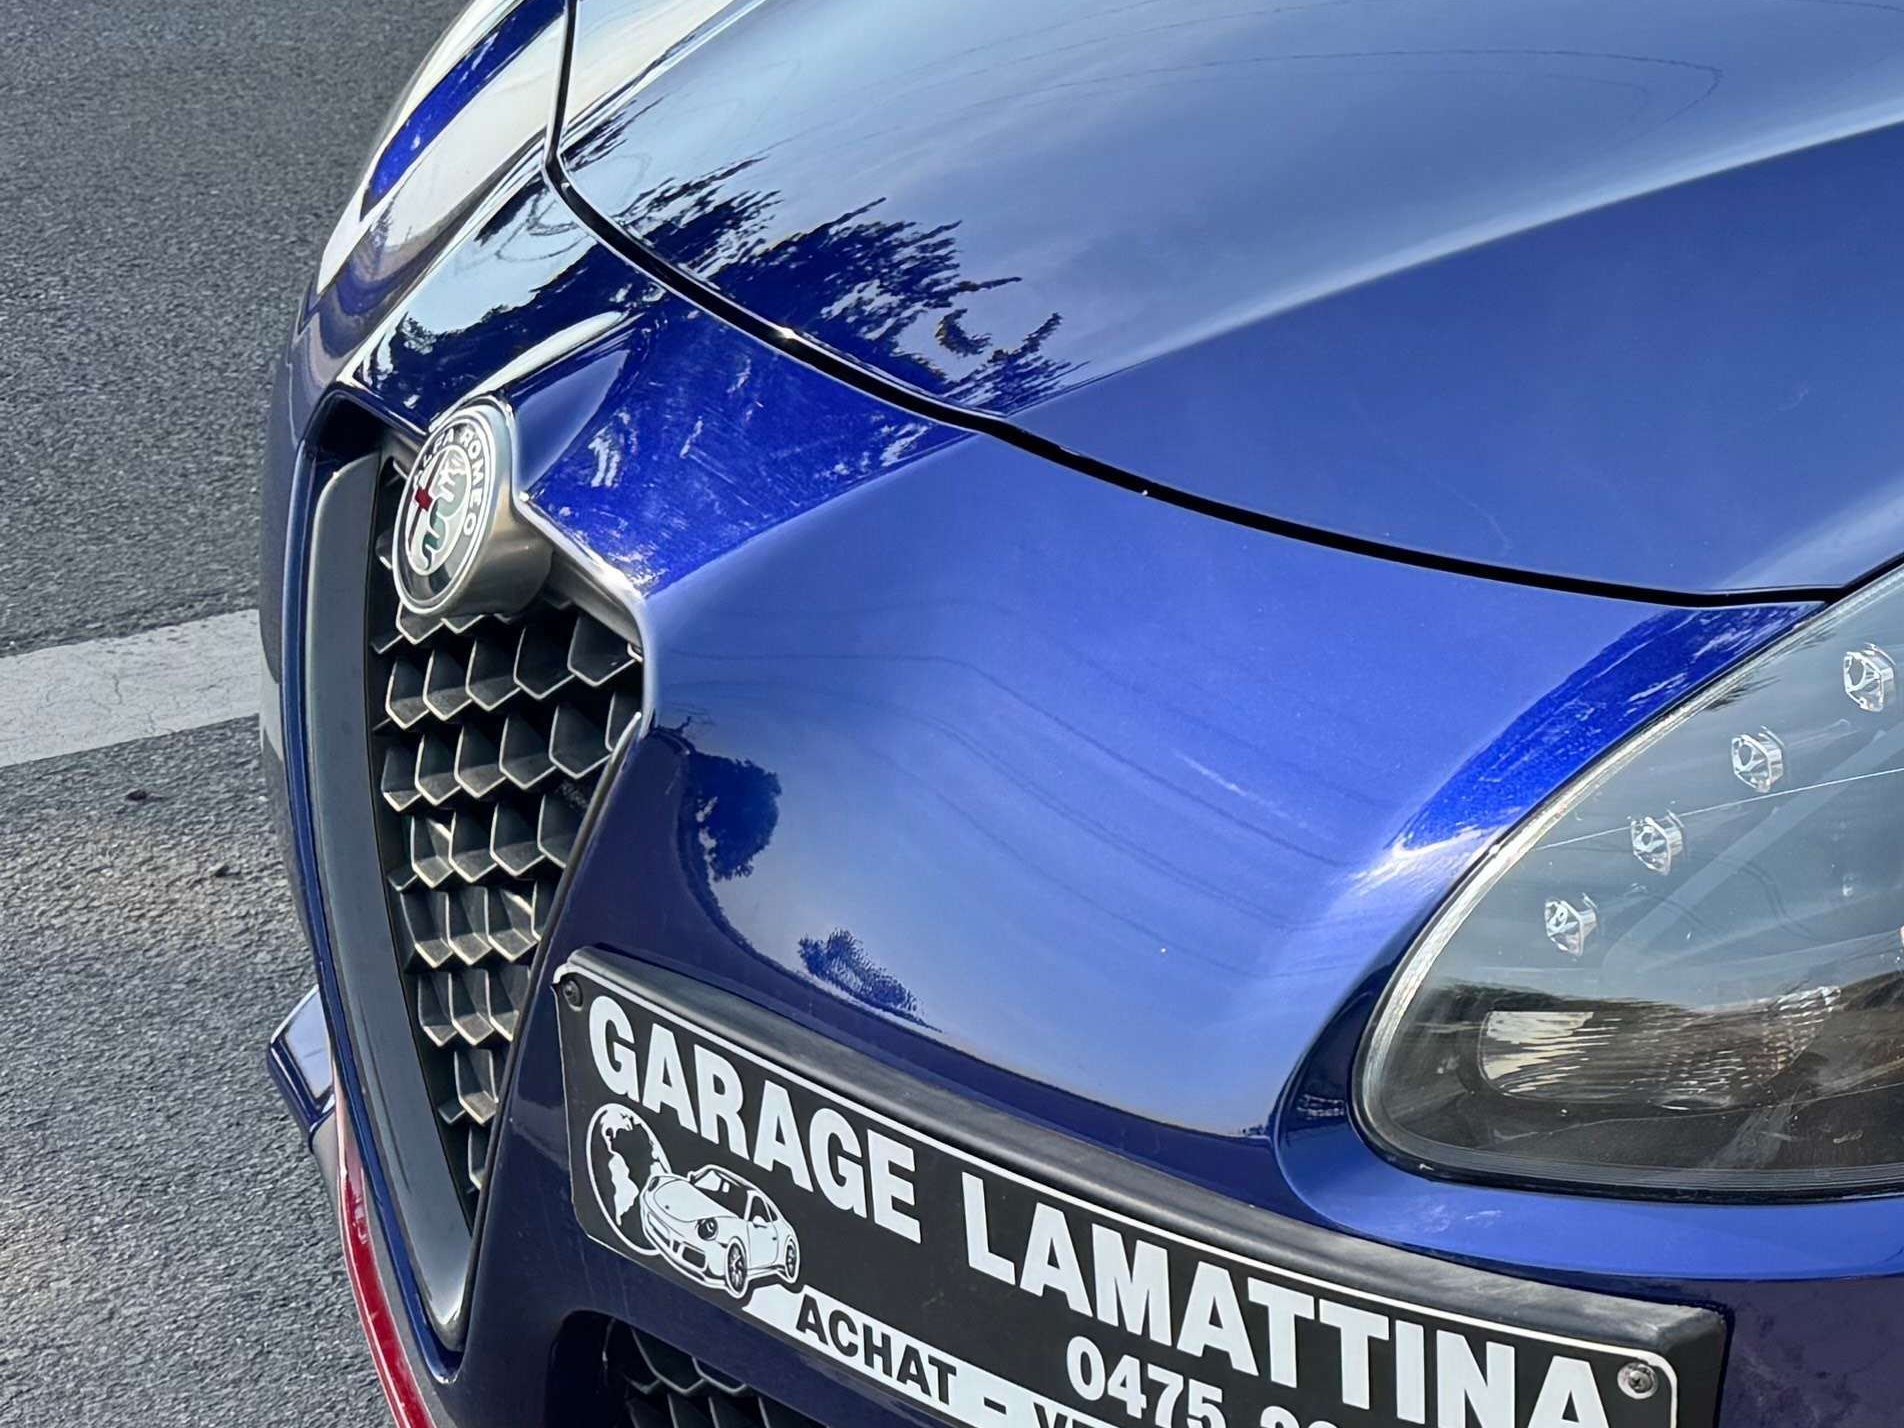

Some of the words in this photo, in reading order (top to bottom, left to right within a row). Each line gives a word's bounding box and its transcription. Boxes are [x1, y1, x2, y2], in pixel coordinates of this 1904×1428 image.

[460, 430, 485, 536] ROMEO
[588, 995, 922, 1244] GARAGE
[795, 1295, 958, 1406] ACHAT
